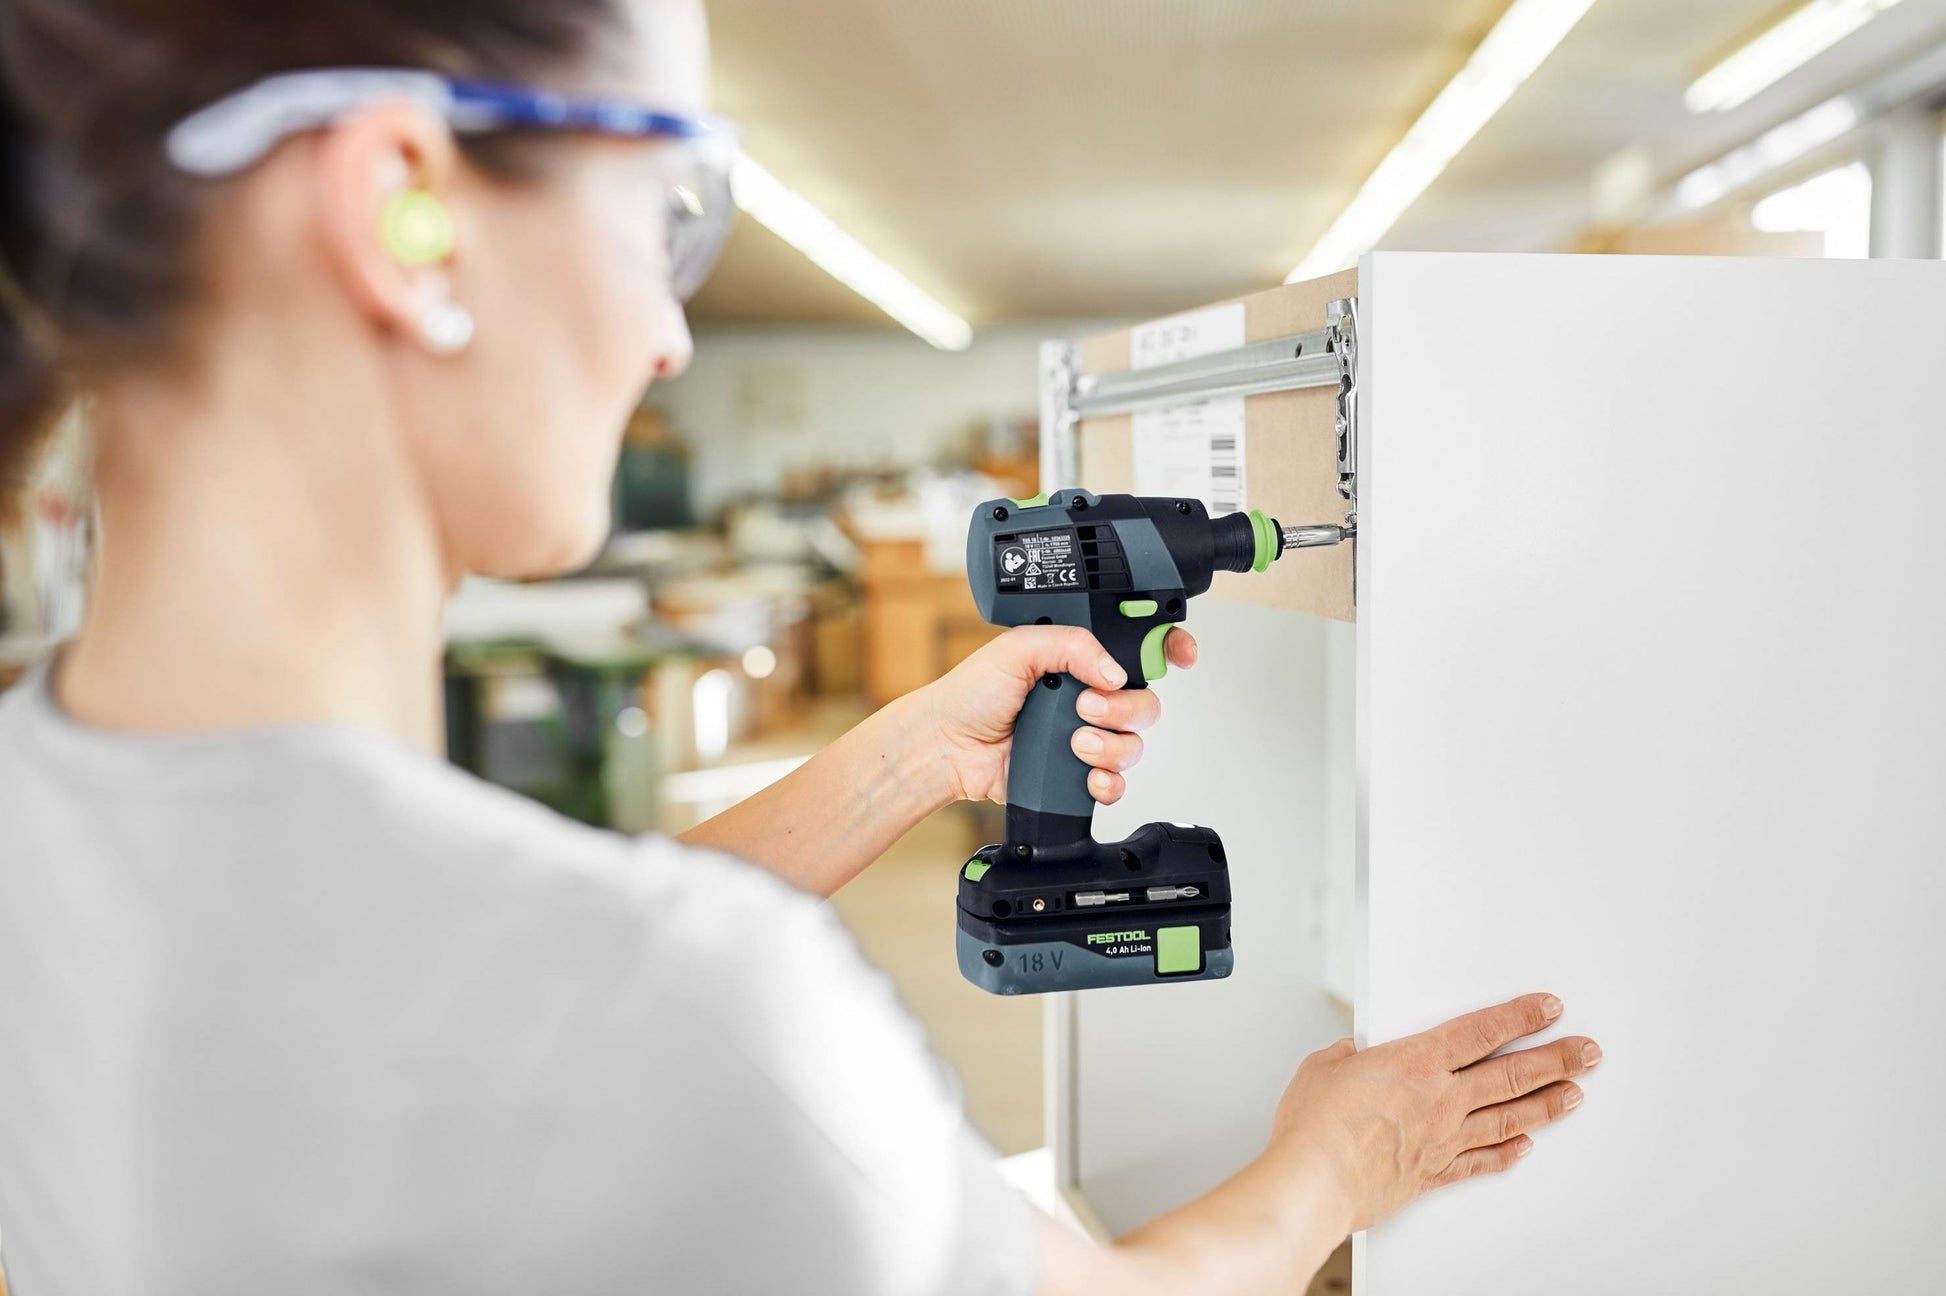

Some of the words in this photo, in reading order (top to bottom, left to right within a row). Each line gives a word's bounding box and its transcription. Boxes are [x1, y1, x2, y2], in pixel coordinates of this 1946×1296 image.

[1059, 568, 1077, 582] CE
[1087, 930, 1151, 945] FESTOOL
[1106, 946, 1118, 955] 4,0
[1130, 944, 1152, 953] Li-Ion
[1019, 952, 1044, 973] 18
[1050, 950, 1064, 970] V
